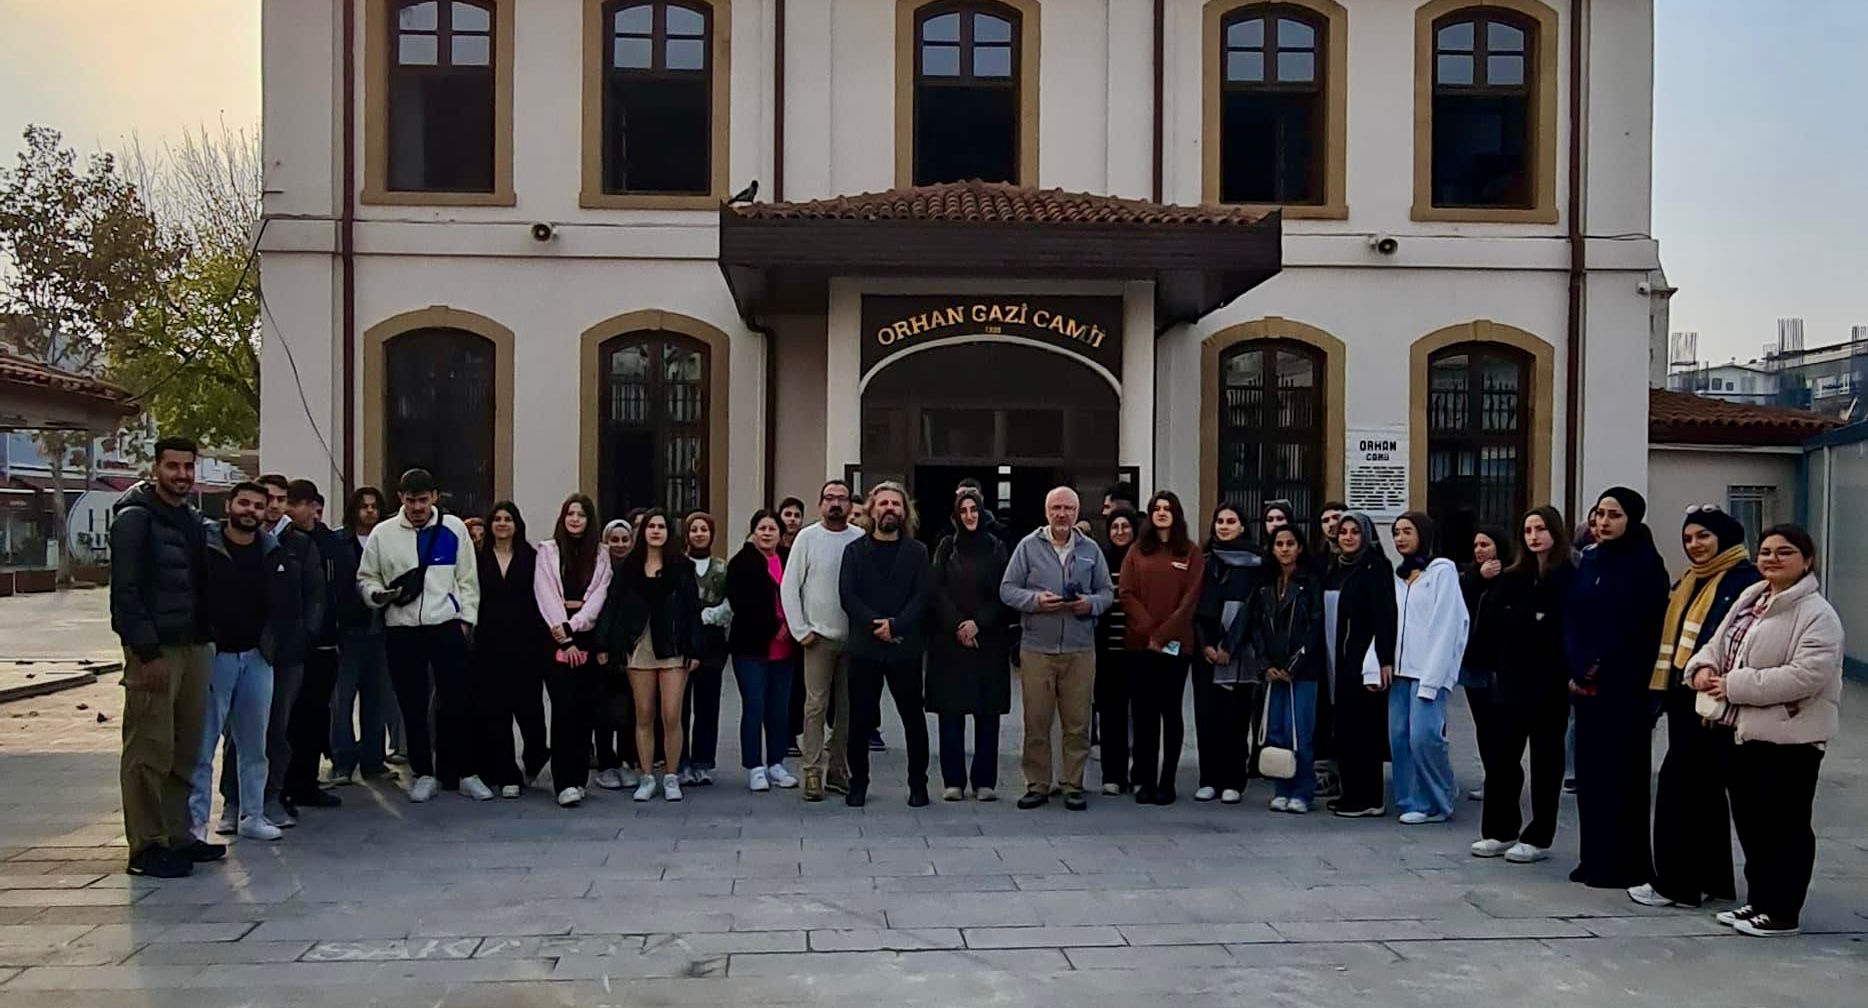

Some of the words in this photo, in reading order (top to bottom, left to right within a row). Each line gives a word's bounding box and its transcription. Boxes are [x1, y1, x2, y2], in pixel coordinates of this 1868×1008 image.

[877, 305, 965, 346] ORHAN
[971, 303, 1028, 325] GAZİ
[1359, 440, 1397, 452] ORHAN
